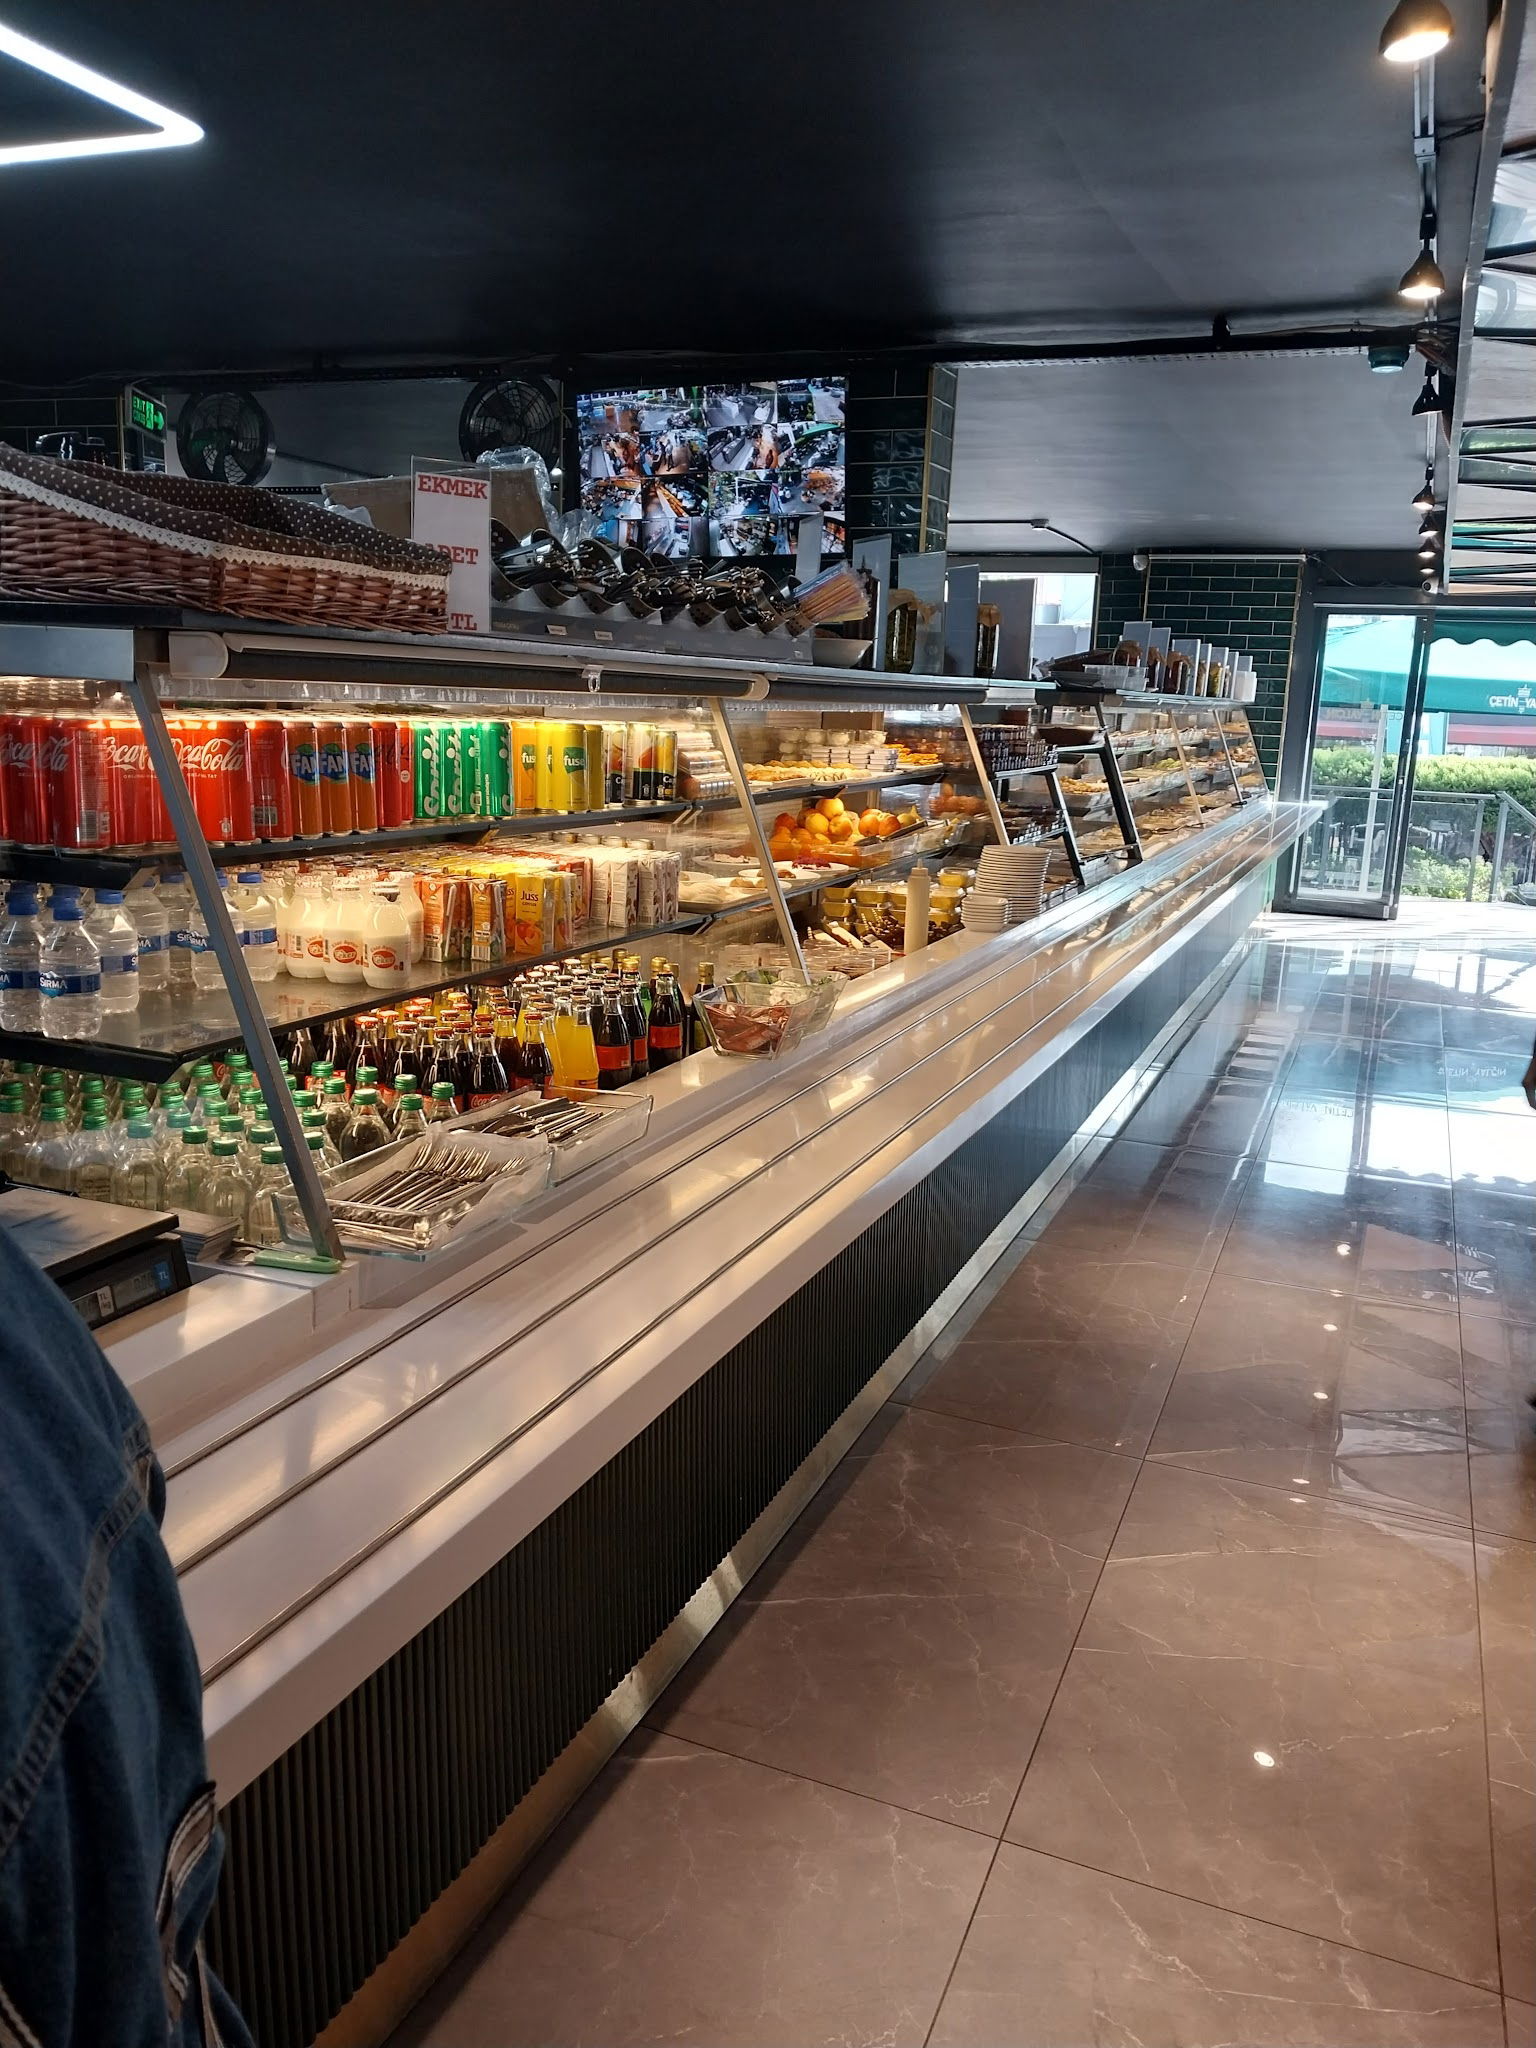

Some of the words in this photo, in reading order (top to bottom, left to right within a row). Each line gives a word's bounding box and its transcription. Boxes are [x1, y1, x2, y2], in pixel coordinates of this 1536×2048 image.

[418, 475, 487, 499] EKMEK
[425, 543, 478, 565] DET
[451, 613, 477, 631] TL
[564, 755, 585, 766] fuse
[520, 890, 539, 902] Juss
[158, 1271, 169, 1281] TL
[99, 1293, 110, 1301] TL
